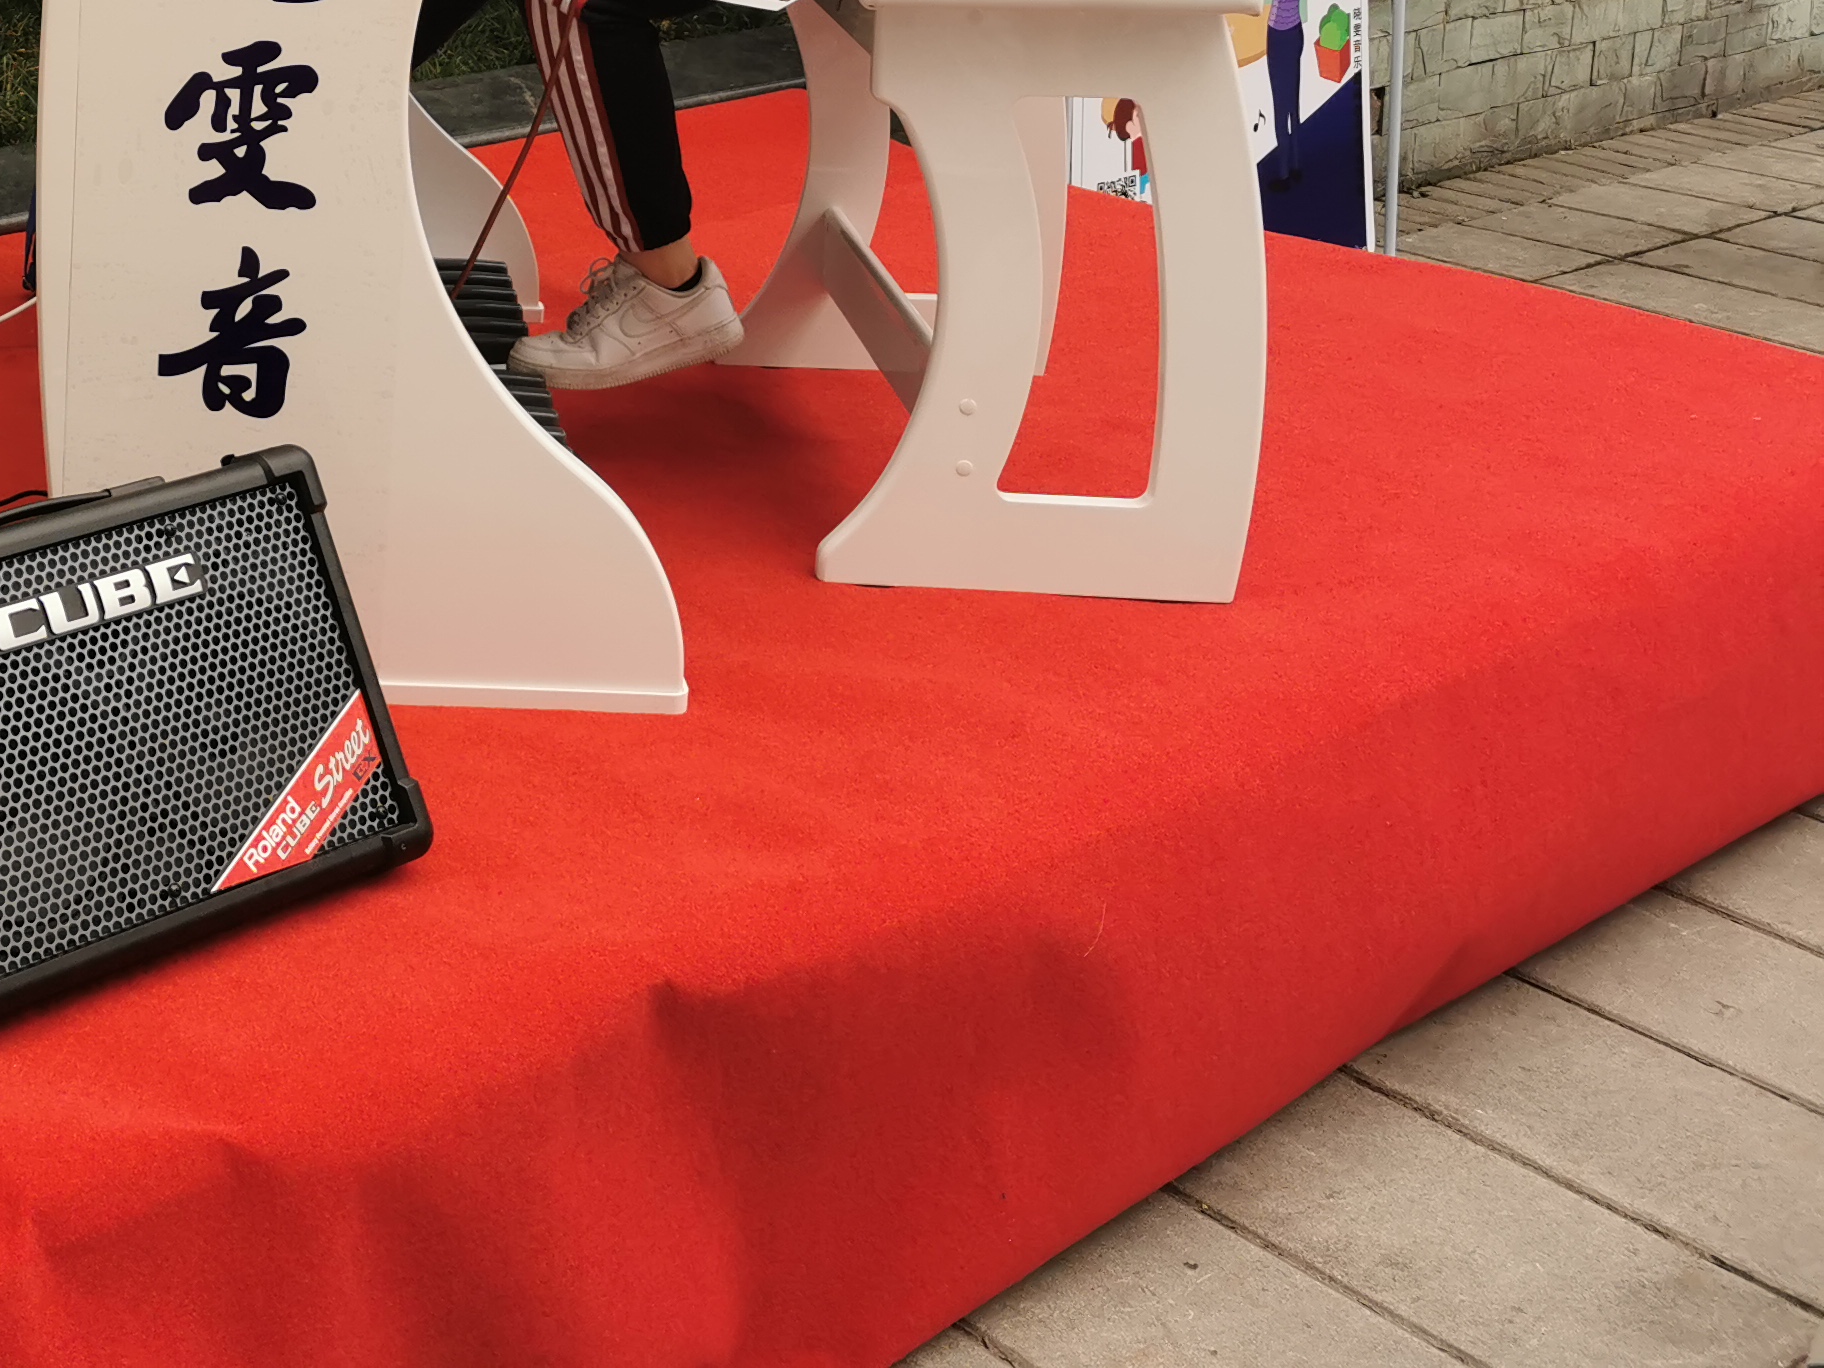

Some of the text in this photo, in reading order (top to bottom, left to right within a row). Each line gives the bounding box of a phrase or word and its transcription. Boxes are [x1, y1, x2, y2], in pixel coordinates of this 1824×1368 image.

[243, 795, 302, 874] Roland
[276, 801, 321, 861] CUBE
[314, 718, 370, 809] Street
